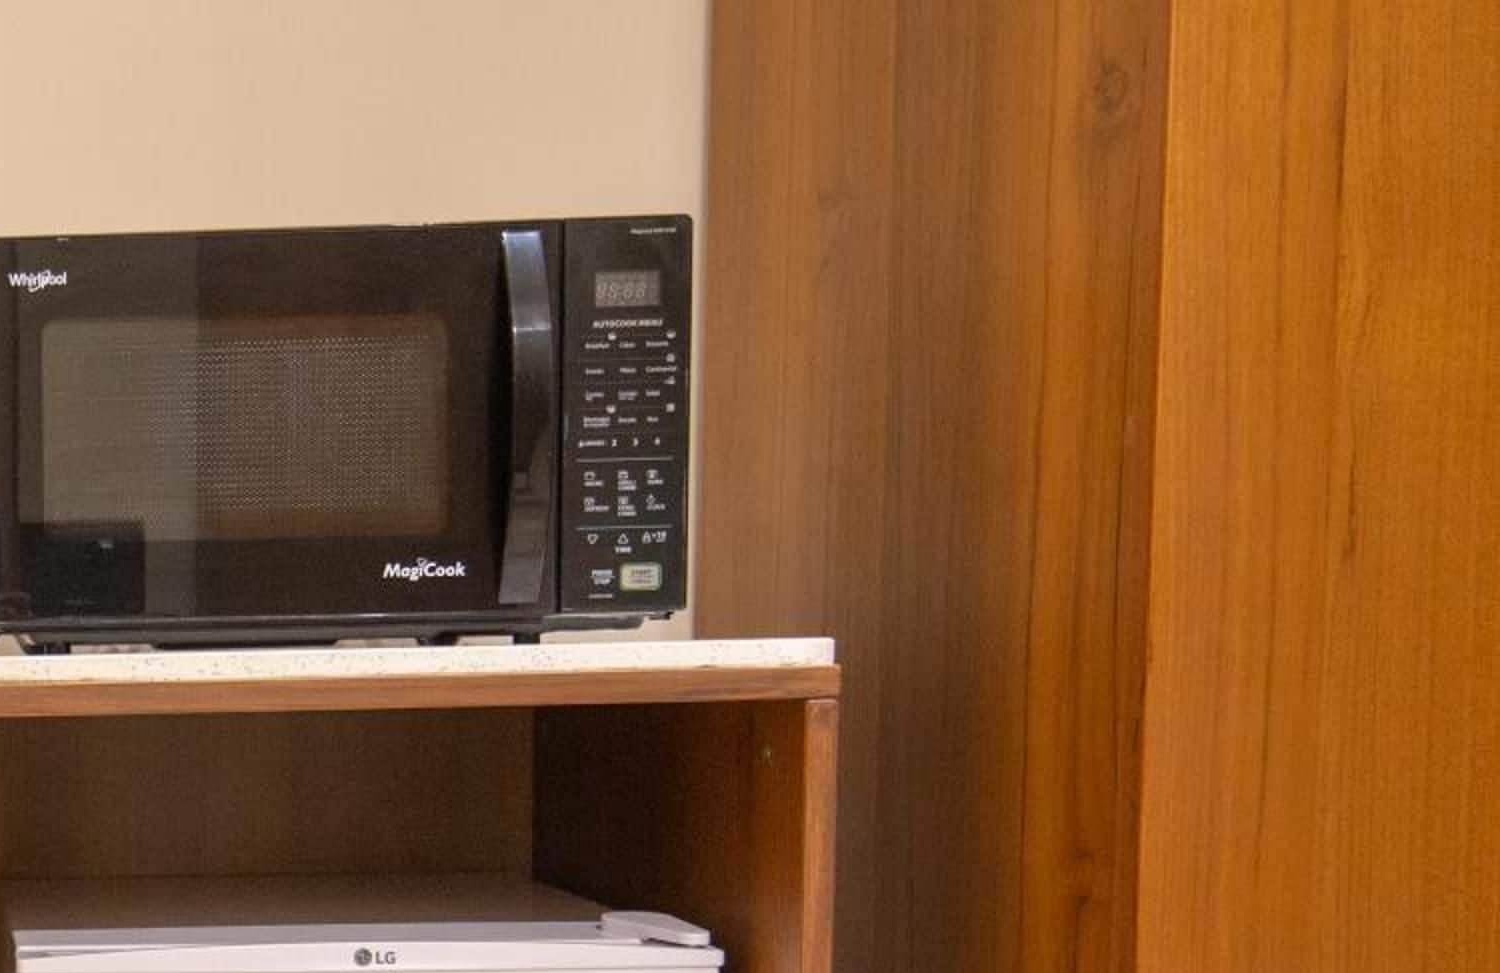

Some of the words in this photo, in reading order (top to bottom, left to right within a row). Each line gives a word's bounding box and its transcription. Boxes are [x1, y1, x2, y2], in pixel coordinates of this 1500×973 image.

[8, 270, 67, 293] Whirlpool
[593, 320, 637, 329] AUTOCOOK
[383, 558, 466, 582] MagiCook
[375, 951, 397, 965] LG
